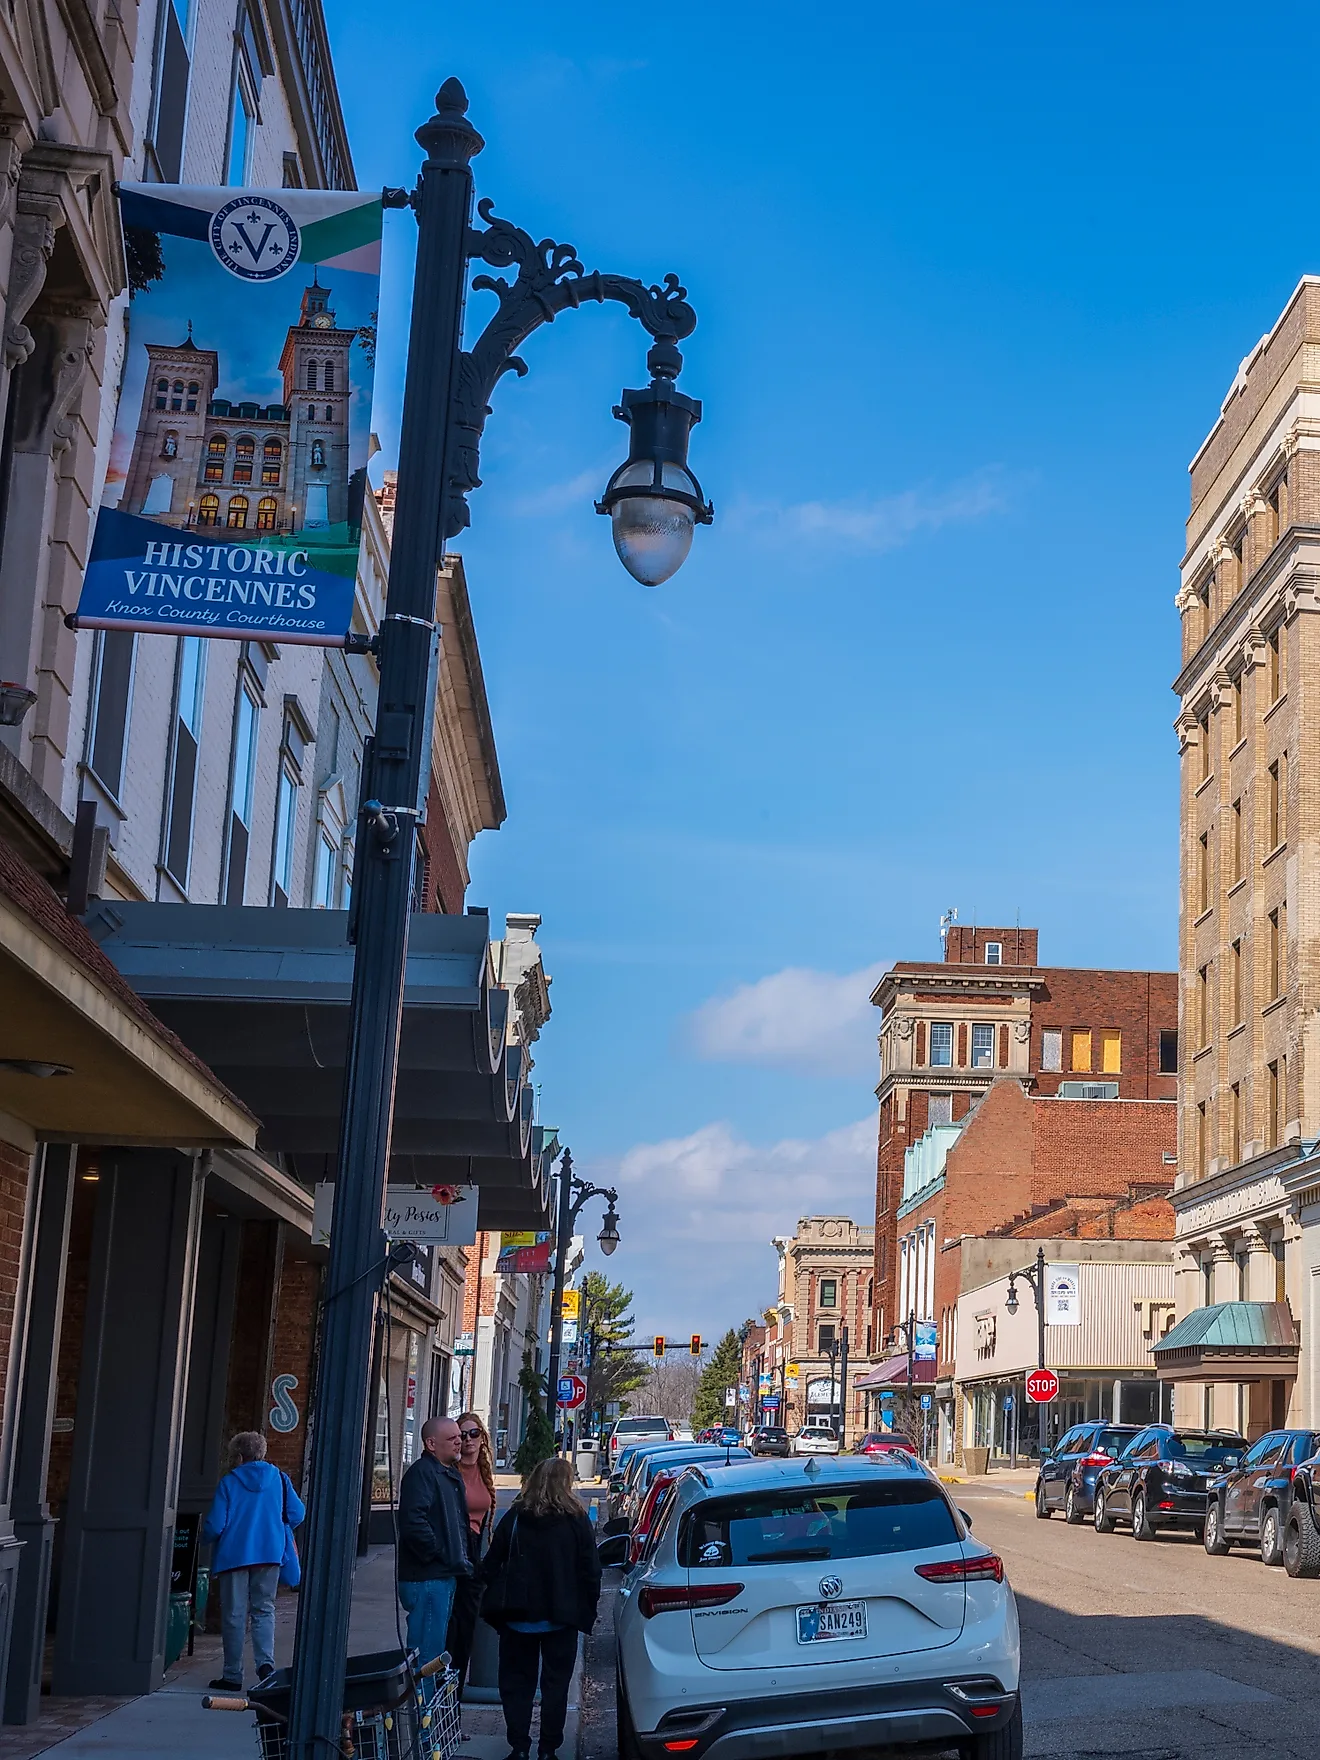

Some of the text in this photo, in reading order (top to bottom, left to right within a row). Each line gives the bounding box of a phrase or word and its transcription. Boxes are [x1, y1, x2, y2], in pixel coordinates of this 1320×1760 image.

[217, 208, 228, 220] OF
[213, 223, 222, 250] CITY
[230, 221, 277, 264] V
[220, 252, 239, 272] THE
[275, 230, 298, 273] INDIANA
[142, 540, 309, 577] HISTORIC
[123, 570, 317, 610] VINCENNES
[105, 599, 326, 630] Knox County Courthouse
[405, 1206, 441, 1223] Posies
[1028, 1379, 1057, 1392] STOP
[694, 1608, 749, 1618] ENVISION
[820, 1611, 862, 1631] SAN249
